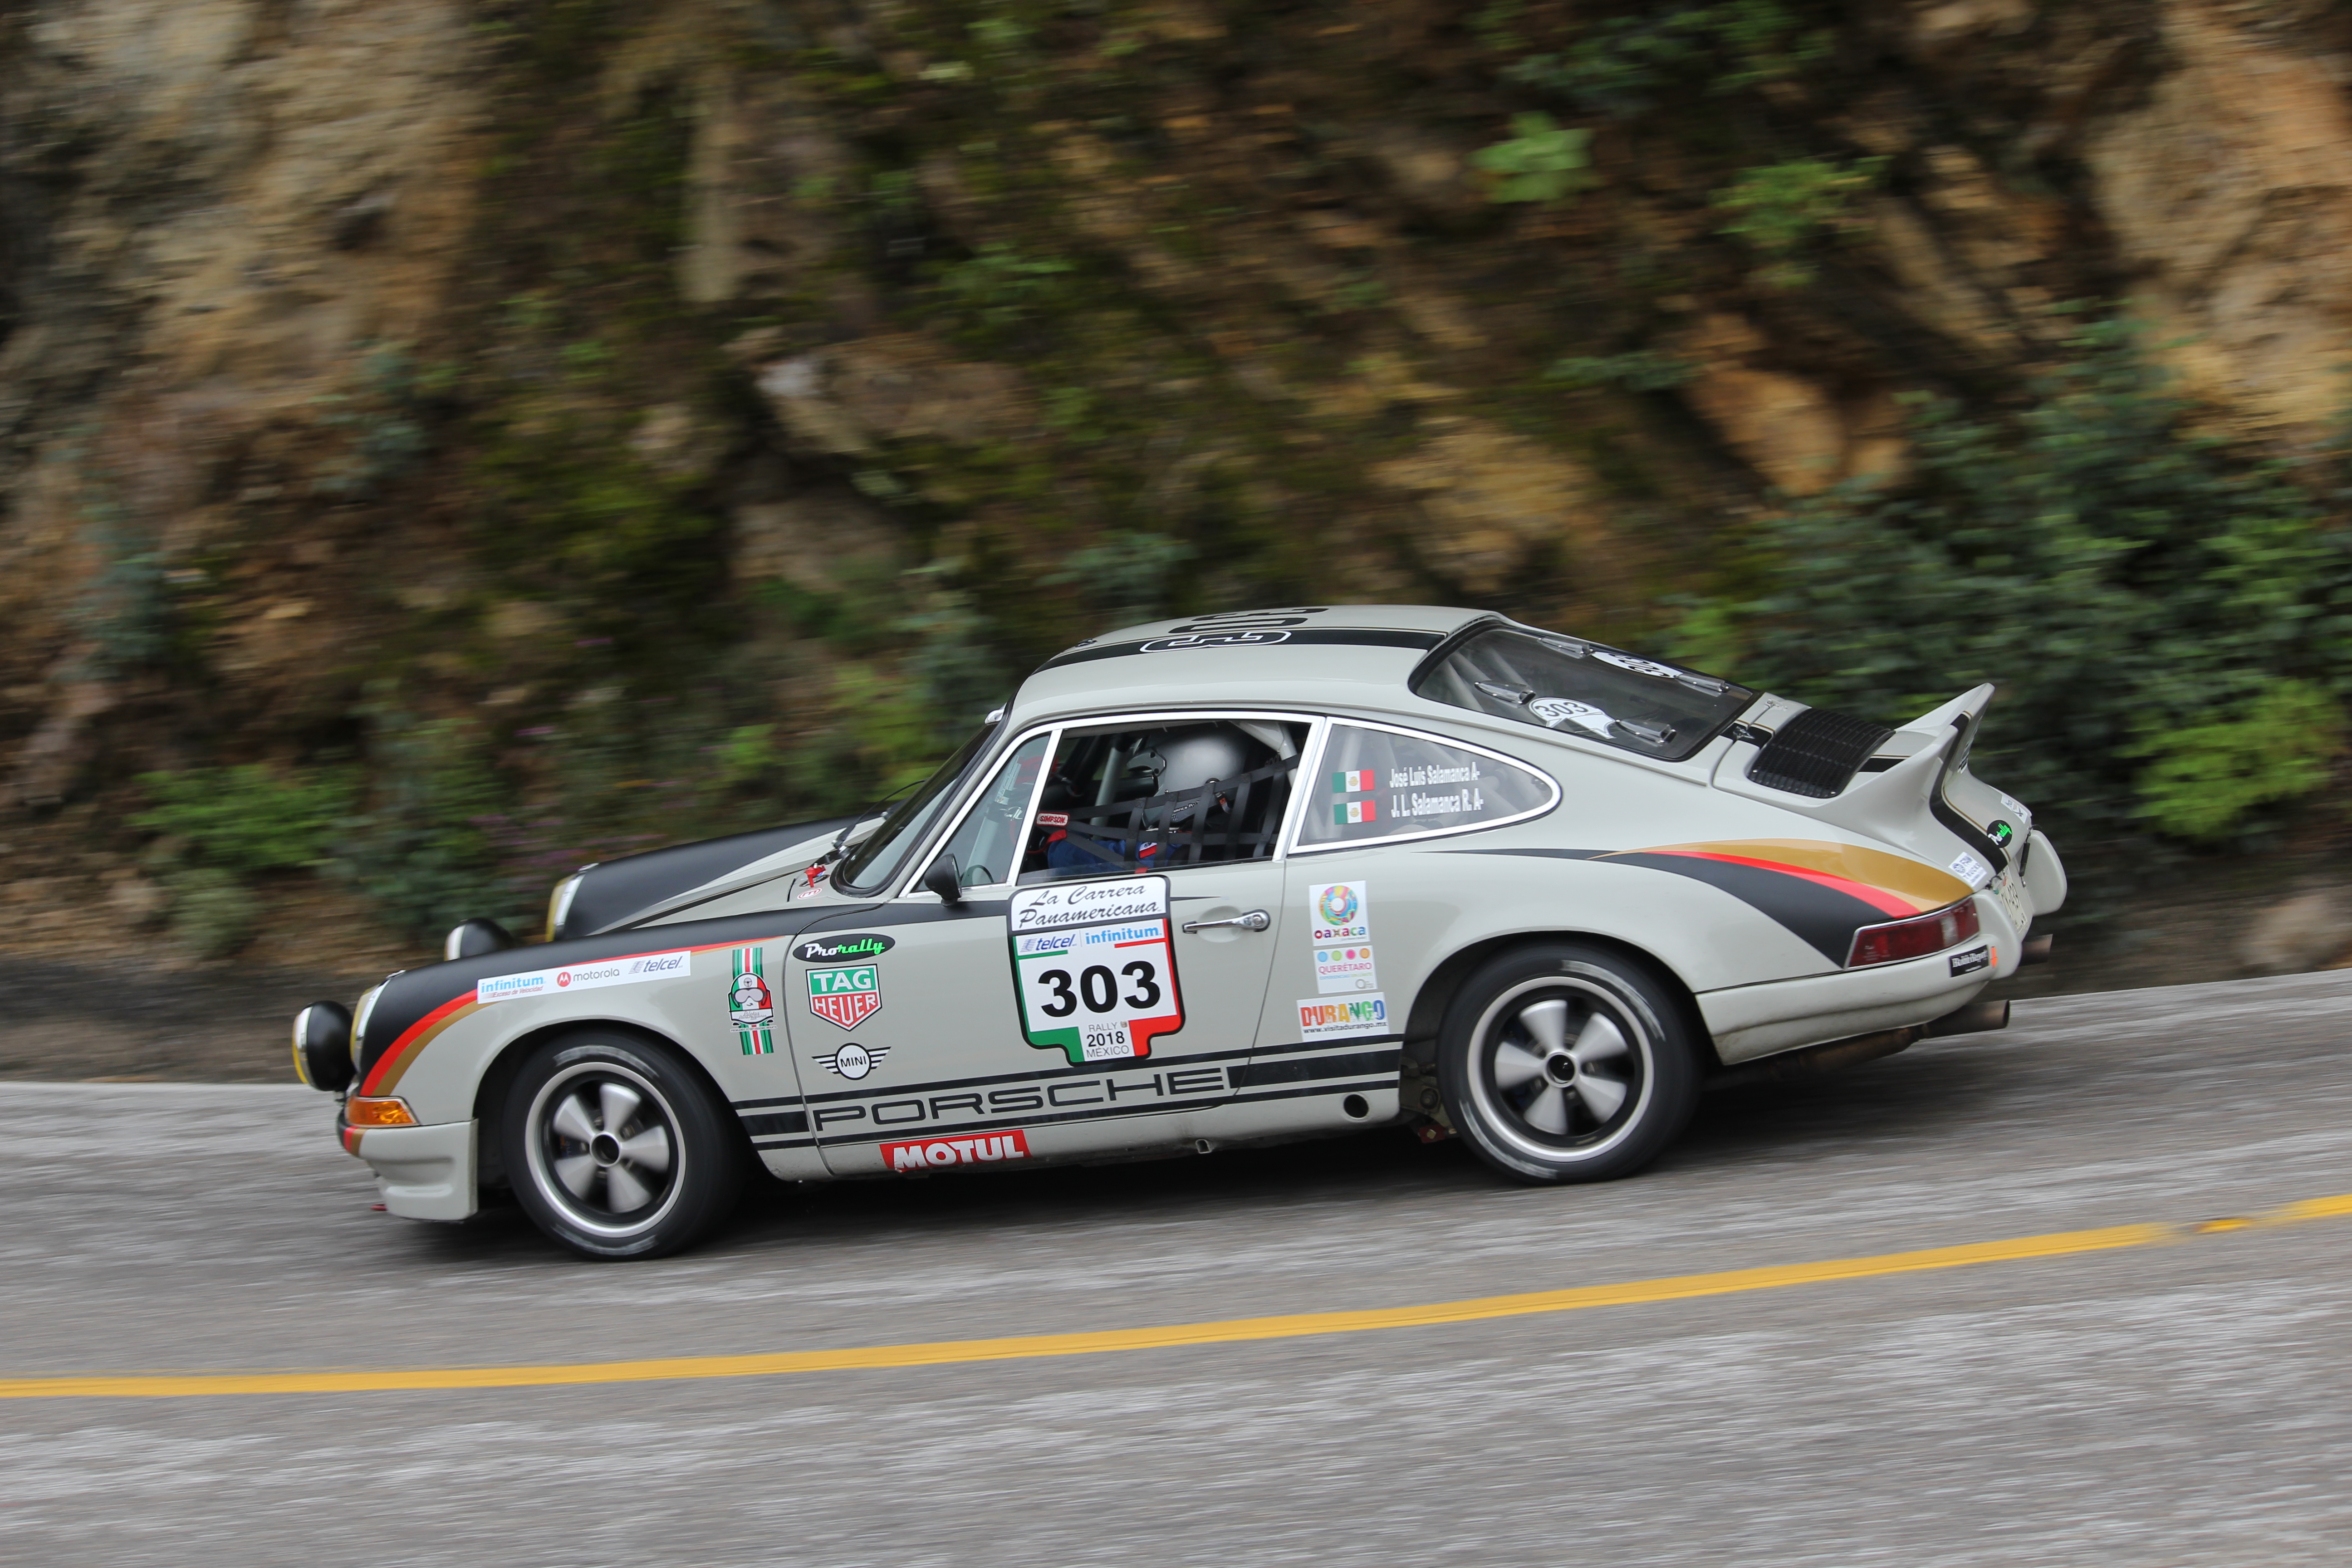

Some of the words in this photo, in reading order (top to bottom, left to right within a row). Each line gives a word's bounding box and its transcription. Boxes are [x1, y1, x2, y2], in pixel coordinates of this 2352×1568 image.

[1534, 702, 1588, 717] 303
[1389, 767, 1408, 788] José
[1409, 766, 1426, 786] Luis
[1427, 764, 1470, 785] Salamanca
[1391, 795, 1401, 818] J.
[1401, 794, 1411, 817] L.
[1411, 792, 1461, 816] Salamanca
[1040, 815, 1065, 823] SIMPSON
[1029, 890, 1059, 906] La
[1068, 885, 1147, 905] Carrera
[1019, 902, 1158, 928] Panamericana
[804, 938, 886, 958] Prorally
[1035, 934, 1076, 951] telcel
[1085, 926, 1159, 945] infinitum
[481, 976, 544, 993] infinitum
[573, 968, 620, 982] motorola
[643, 956, 683, 972] telcel
[1318, 962, 1372, 975] QUERÉTARO
[519, 985, 544, 994] Velocidad
[813, 970, 872, 992] TAG
[1038, 961, 1161, 1017] 303
[814, 994, 877, 1025] HEUER
[1300, 1000, 1385, 1026] DURANGO
[1088, 1022, 1117, 1033] RALLY
[1087, 1031, 1125, 1047] 2018
[840, 1056, 867, 1068] MINI
[1086, 1045, 1129, 1058] MÉXICO
[813, 1068, 1224, 1131] PORSCHE
[893, 1135, 1024, 1171] MOTUL
